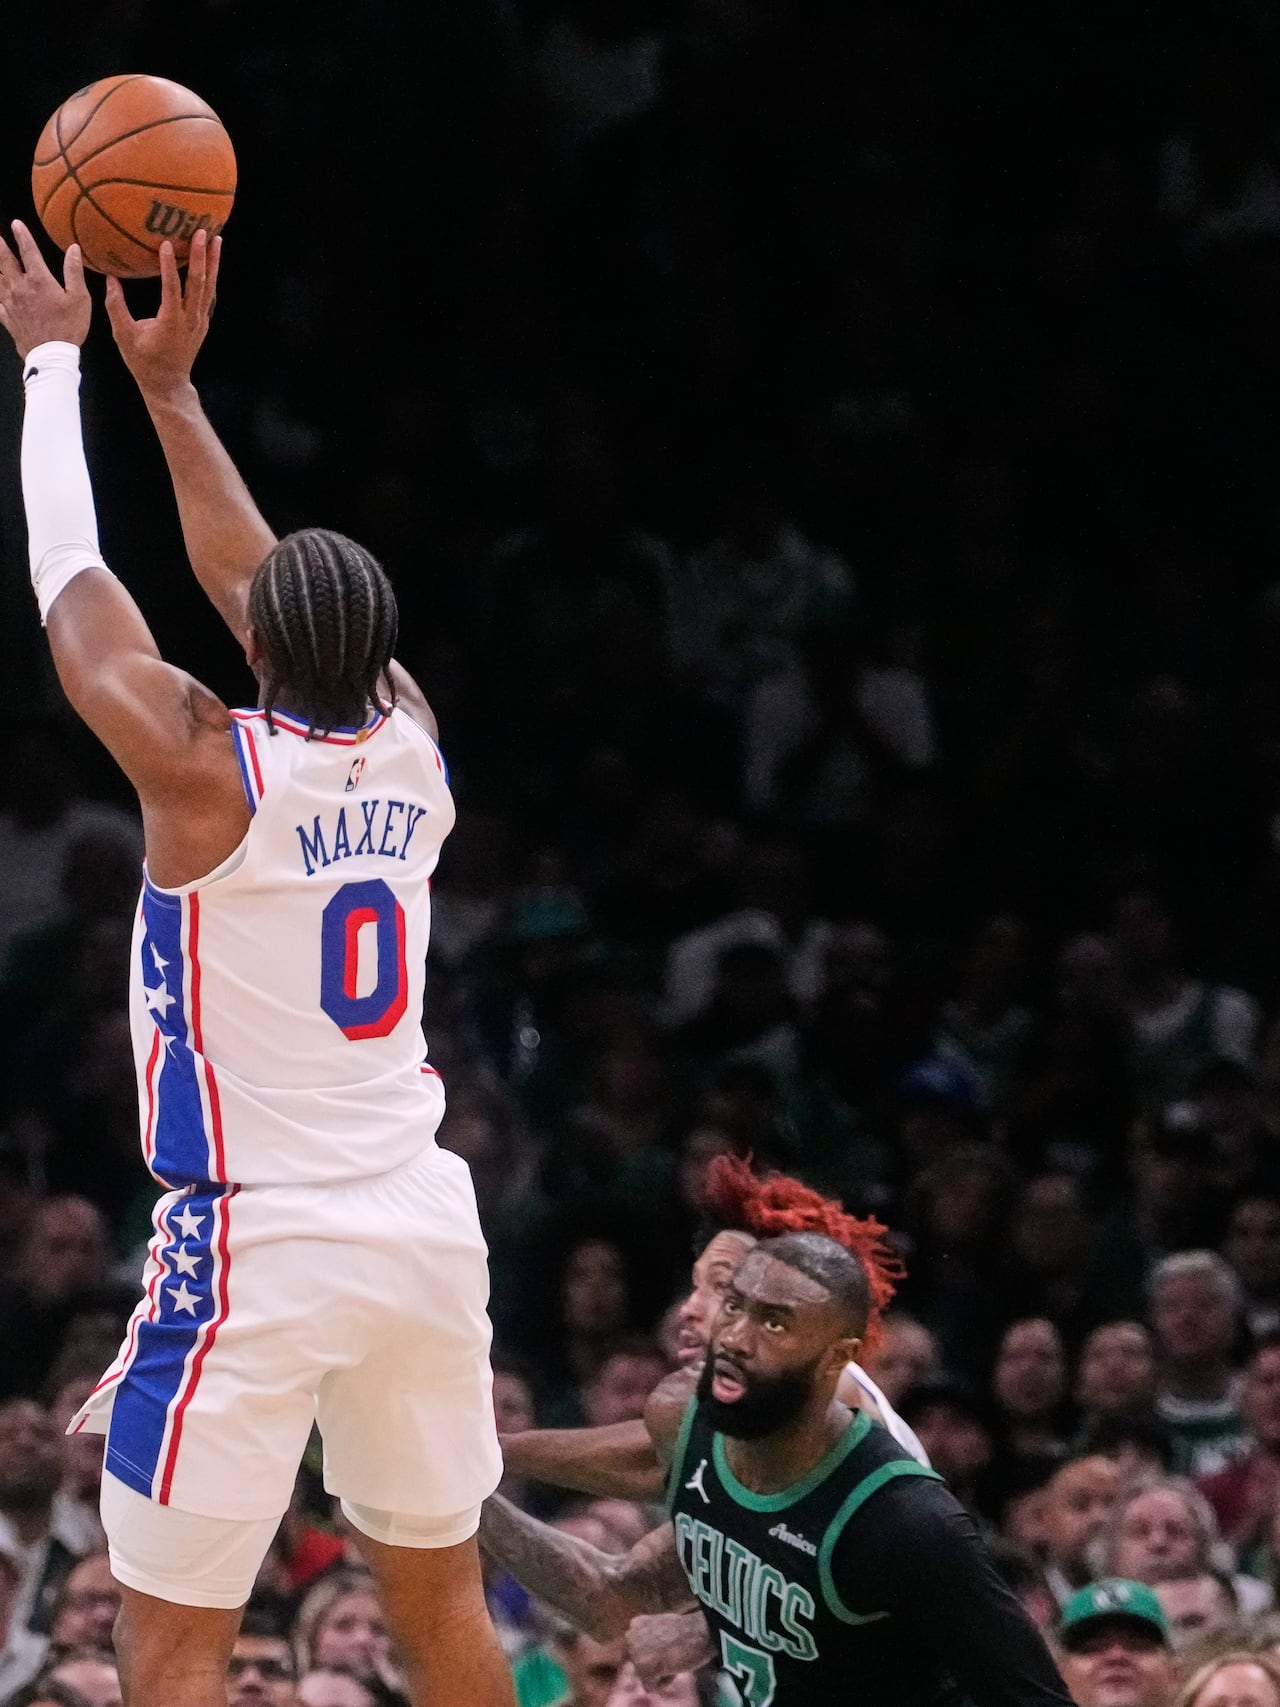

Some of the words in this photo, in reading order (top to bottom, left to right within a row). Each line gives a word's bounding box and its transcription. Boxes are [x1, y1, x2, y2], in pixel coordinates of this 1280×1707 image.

[144, 198, 223, 242] Wil
[295, 799, 426, 877] MAXEY
[320, 878, 408, 1041] 0
[768, 1523, 817, 1557] Amica
[675, 1512, 819, 1661] CELTICS
